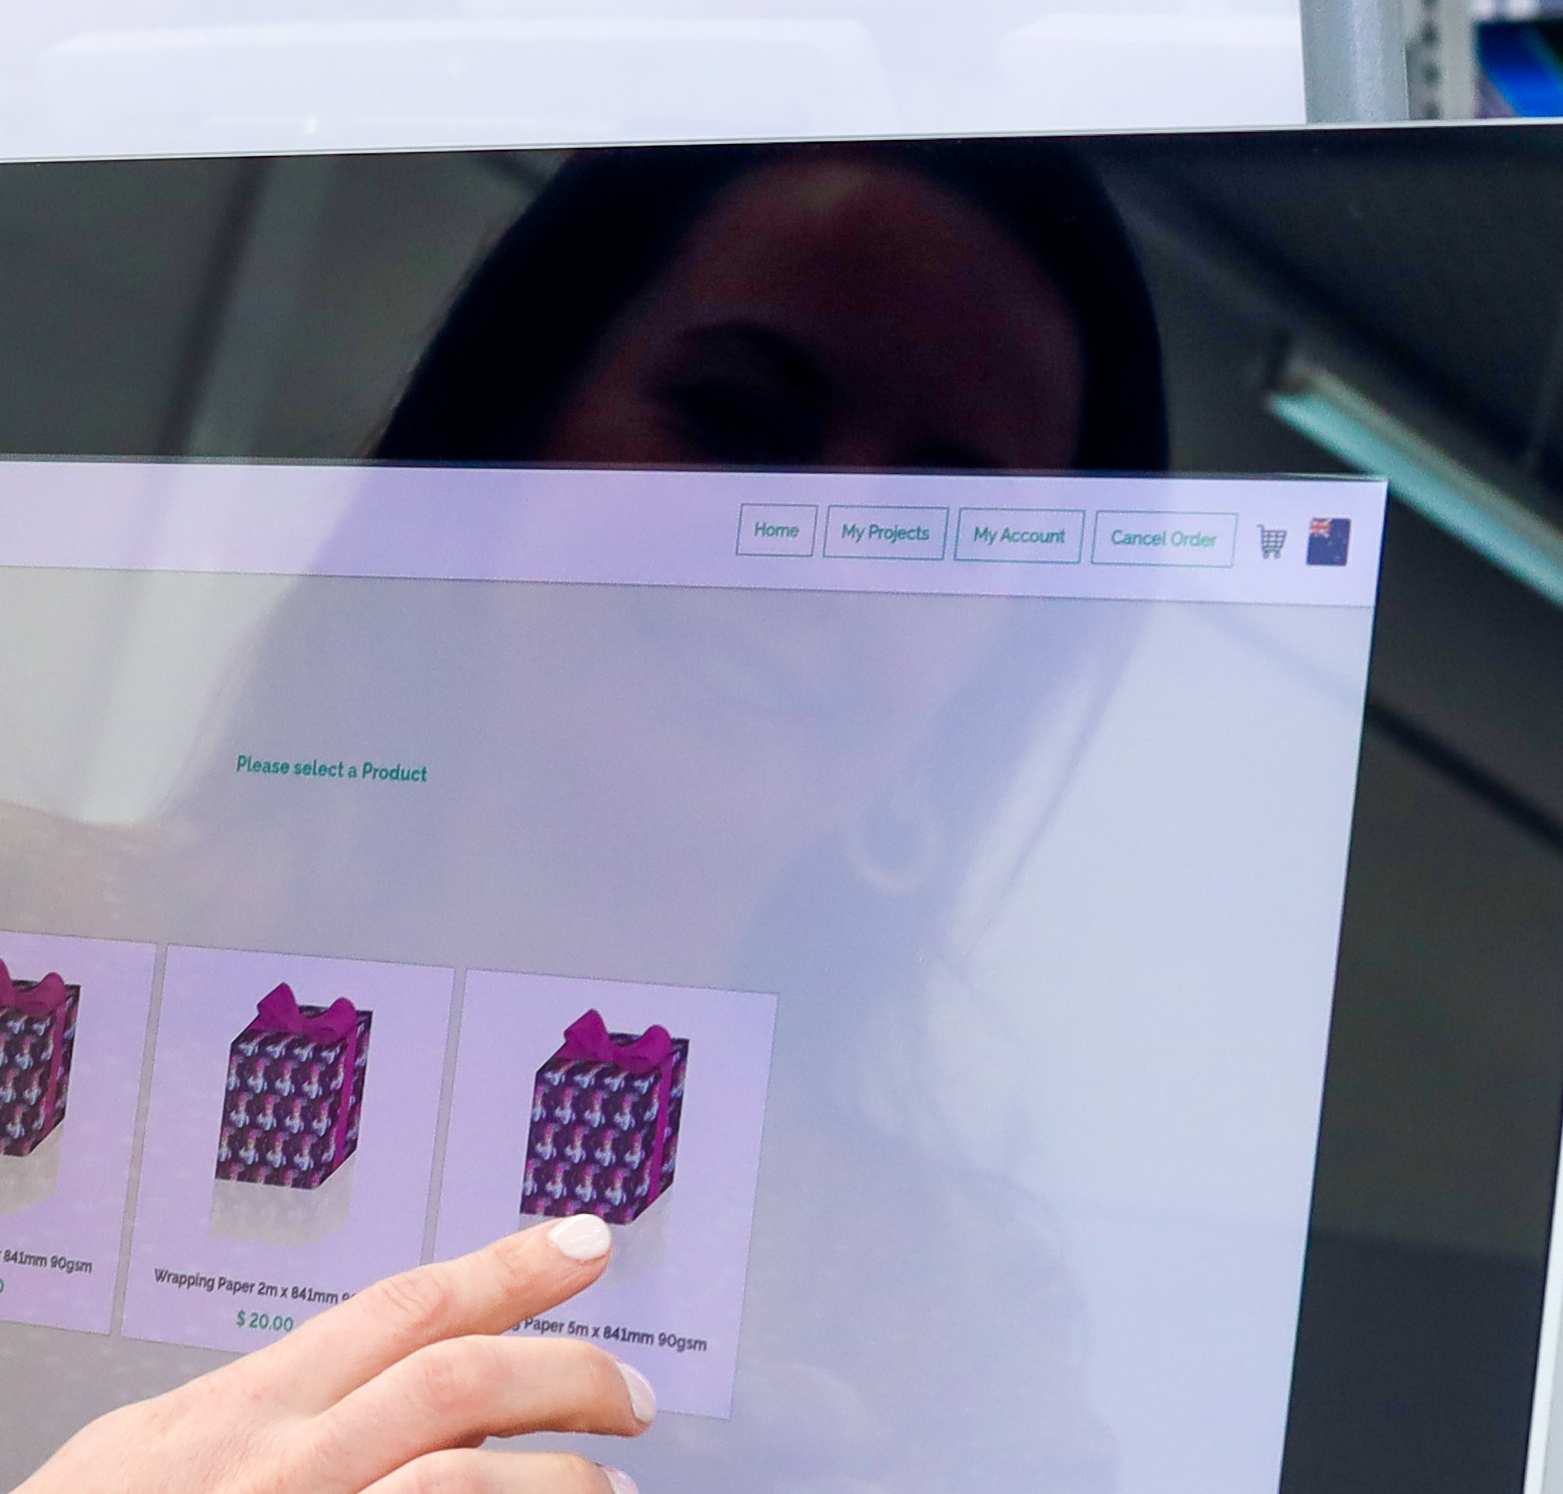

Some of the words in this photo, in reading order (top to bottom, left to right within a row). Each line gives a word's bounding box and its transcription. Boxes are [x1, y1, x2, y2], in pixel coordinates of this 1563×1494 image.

[754, 521, 800, 539] Home
[841, 523, 865, 542] My
[867, 524, 930, 543] Projects
[974, 526, 999, 545] My
[1001, 527, 1065, 544] Account
[1111, 528, 1167, 547] Cancel
[1171, 530, 1217, 548] Order
[236, 755, 290, 774] Please
[294, 760, 344, 777] select
[348, 768, 358, 778] a
[362, 762, 428, 782] Product
[4, 1250, 48, 1268] 841mm
[51, 1256, 93, 1274] 90gsm
[155, 1267, 215, 1291] Wrapping
[218, 1275, 255, 1295] Paper
[258, 1280, 279, 1297] 2m
[280, 1287, 289, 1298] x
[290, 1286, 339, 1305] 841mm
[524, 1316, 565, 1336] Paper
[567, 1320, 590, 1338] 5m
[591, 1327, 601, 1339] x
[603, 1325, 655, 1346] 841mm
[658, 1331, 708, 1352] 90gsm
